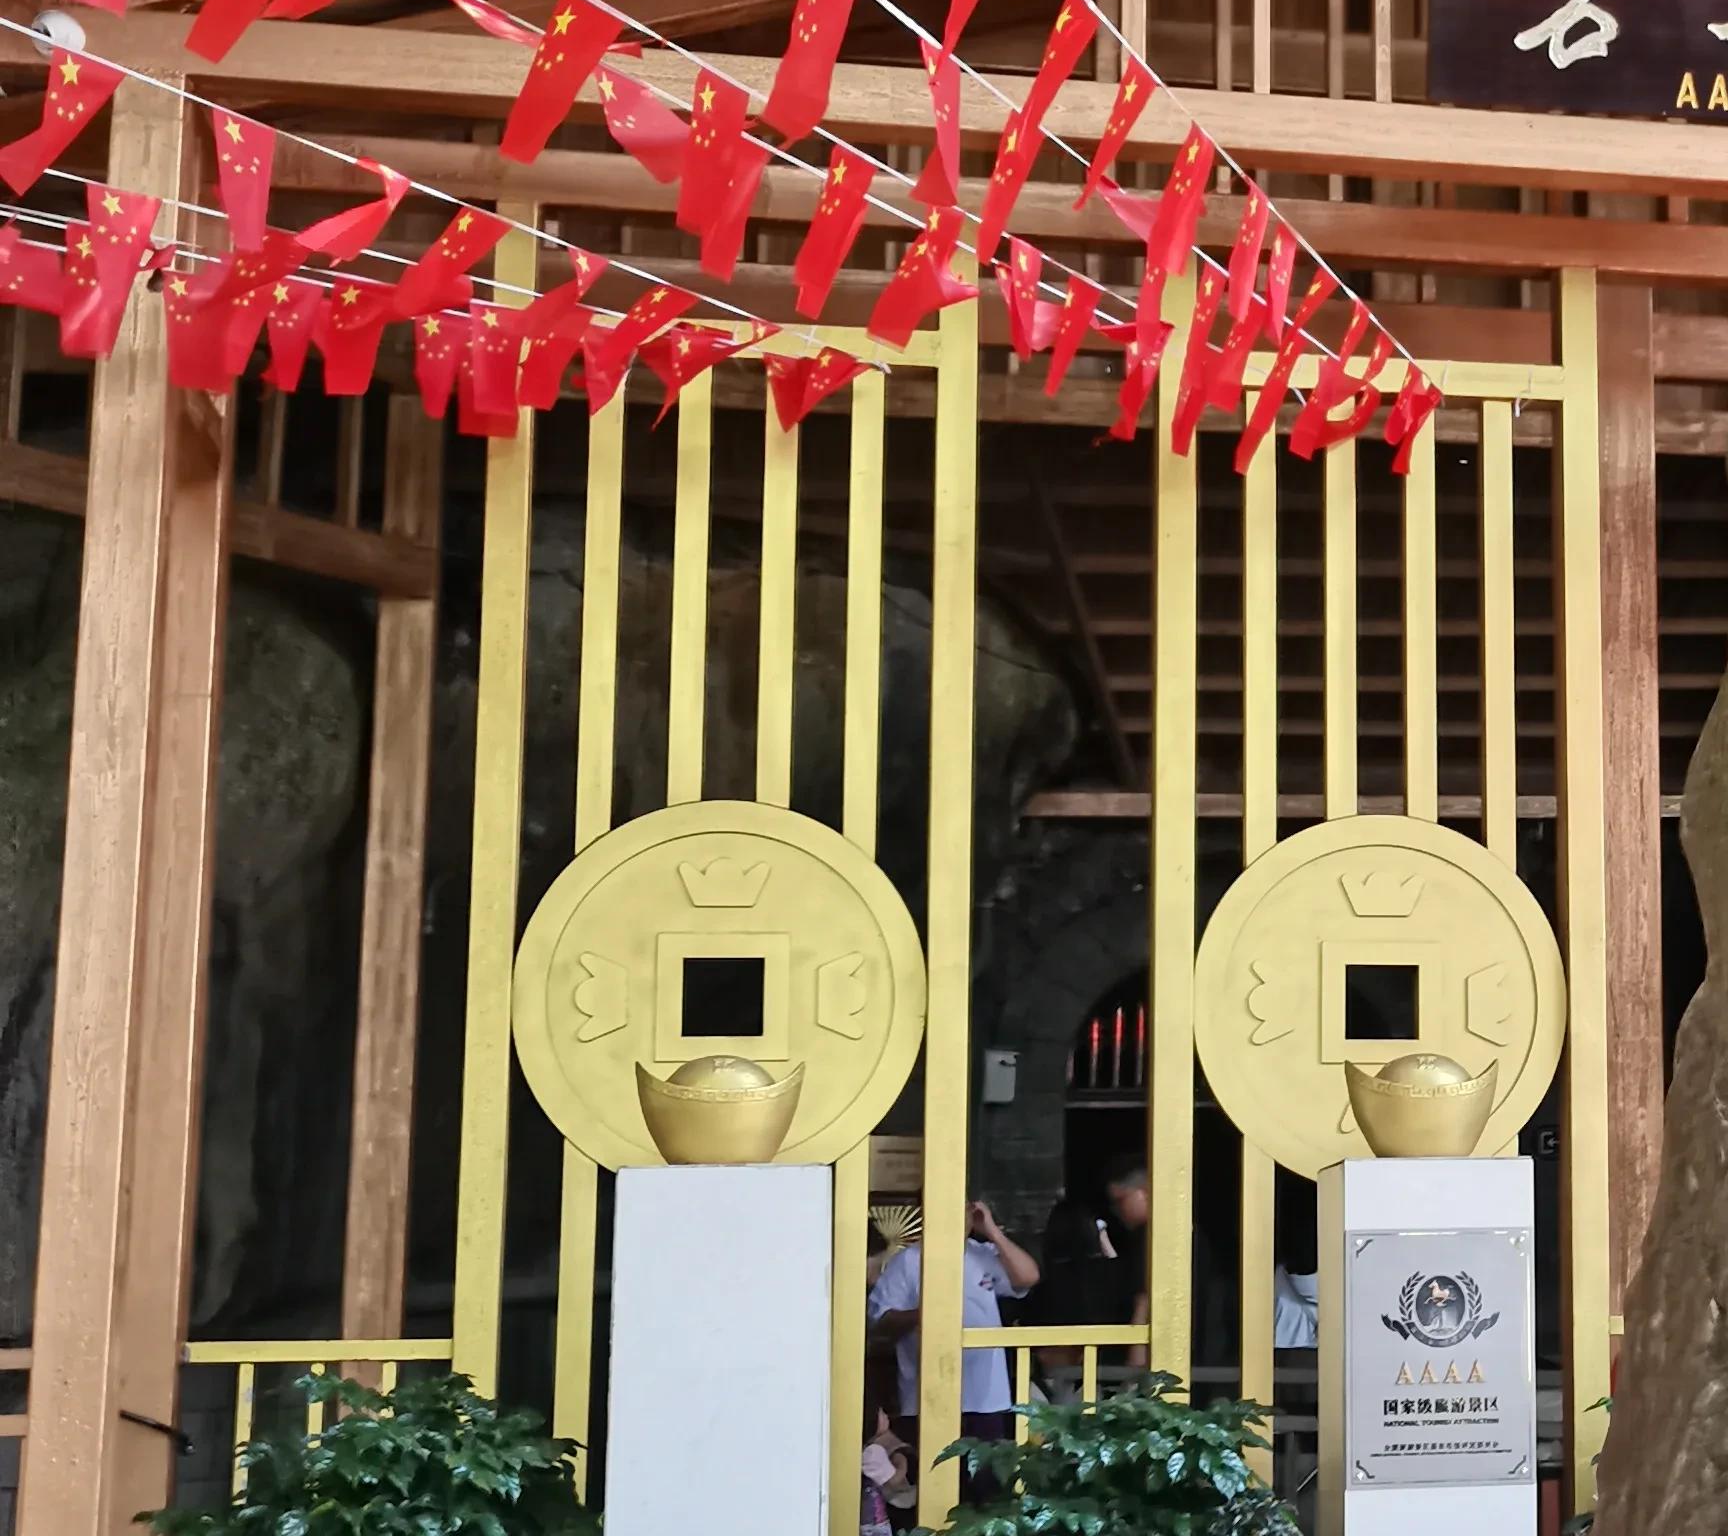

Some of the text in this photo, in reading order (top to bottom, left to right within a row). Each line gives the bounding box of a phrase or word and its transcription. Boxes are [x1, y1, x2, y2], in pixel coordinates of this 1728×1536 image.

[1395, 1359, 1486, 1385] AAAA
[1383, 1396, 1499, 1416] 国家级旅游景区
